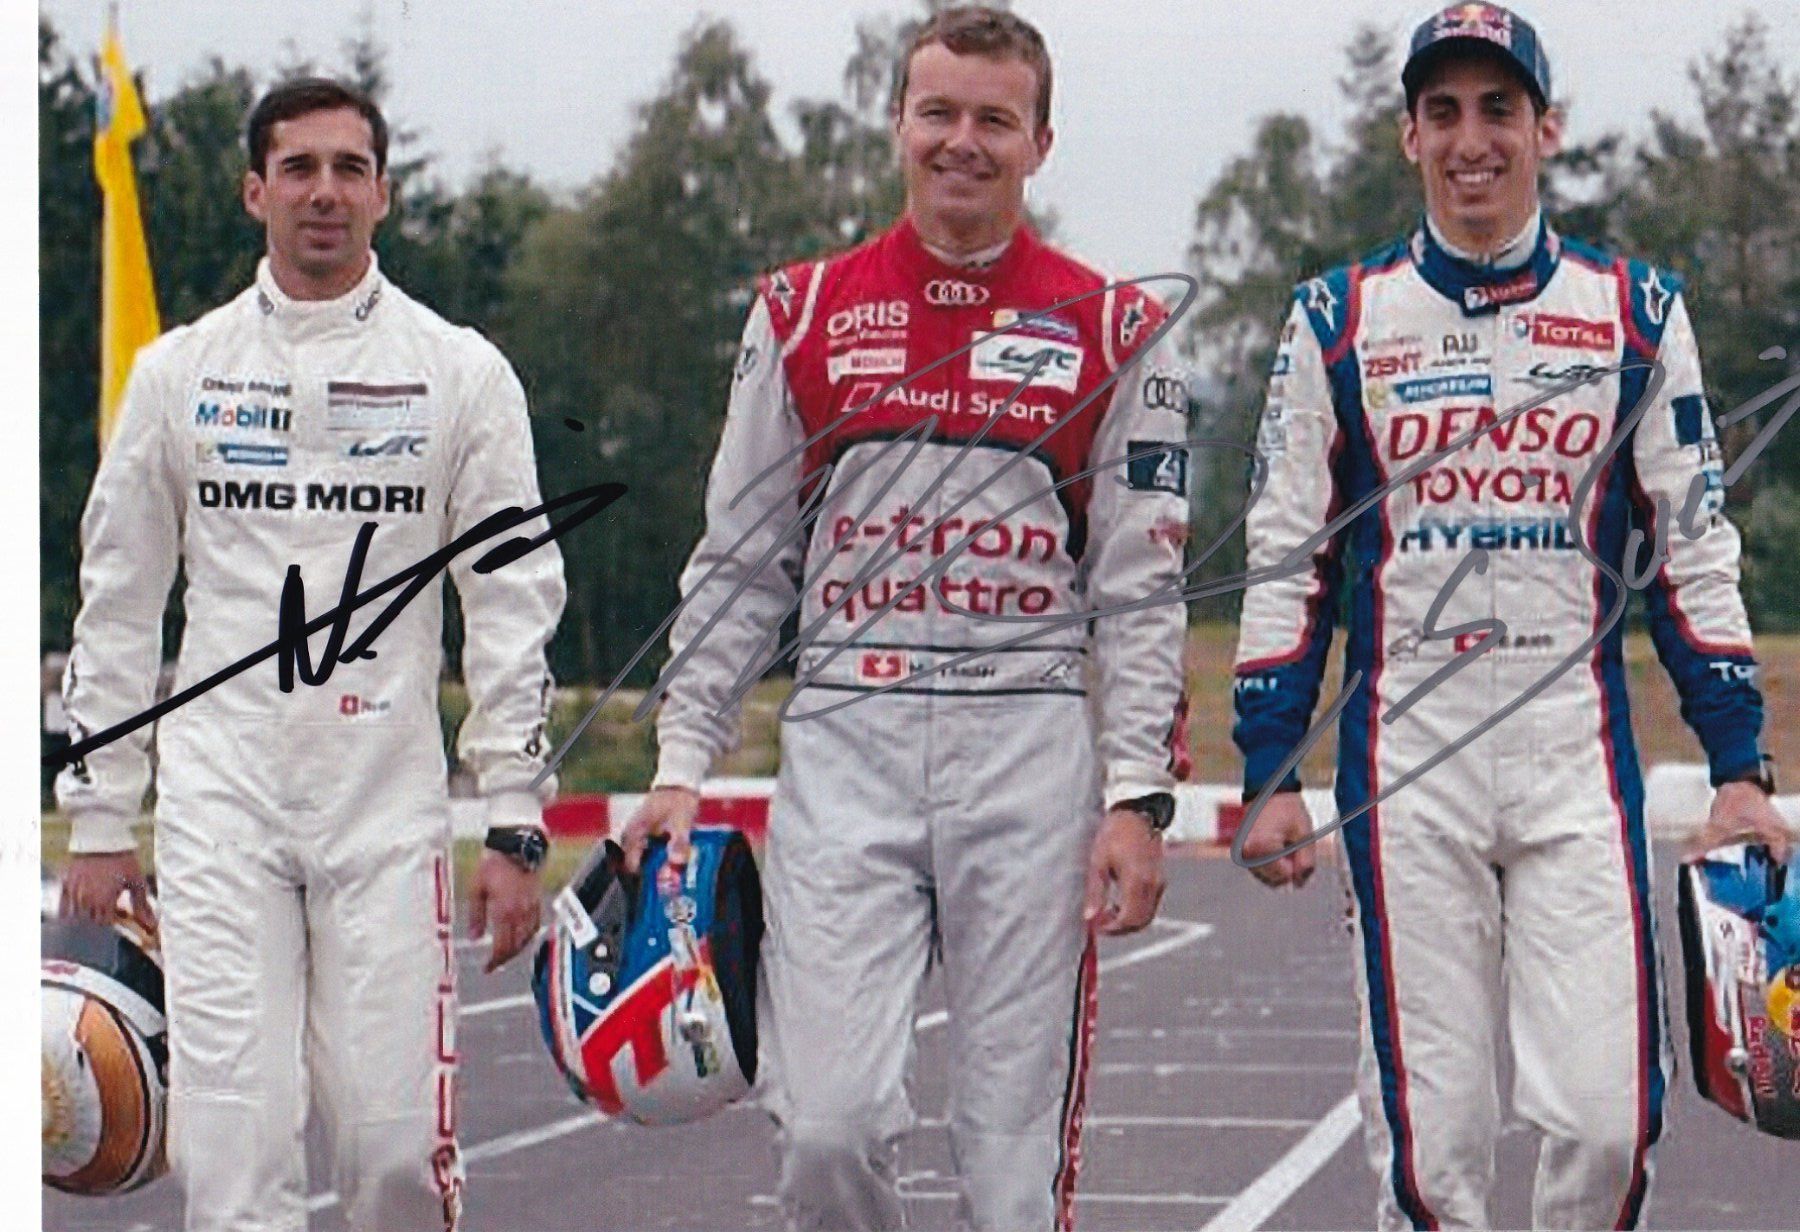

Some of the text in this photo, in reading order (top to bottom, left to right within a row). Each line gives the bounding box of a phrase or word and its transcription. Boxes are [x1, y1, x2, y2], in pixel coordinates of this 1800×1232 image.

[827, 300, 909, 337] ORIS
[1536, 321, 1612, 345] TOTAL
[1363, 352, 1422, 378] ZENT
[195, 402, 266, 427] Mobil
[883, 386, 1058, 425] Audi Sport
[1390, 406, 1600, 461] DENSO
[198, 481, 425, 512] DMG MORI
[1415, 466, 1573, 505] TOYOTA
[832, 506, 1057, 563] e-tron
[821, 576, 1053, 622] quattro
